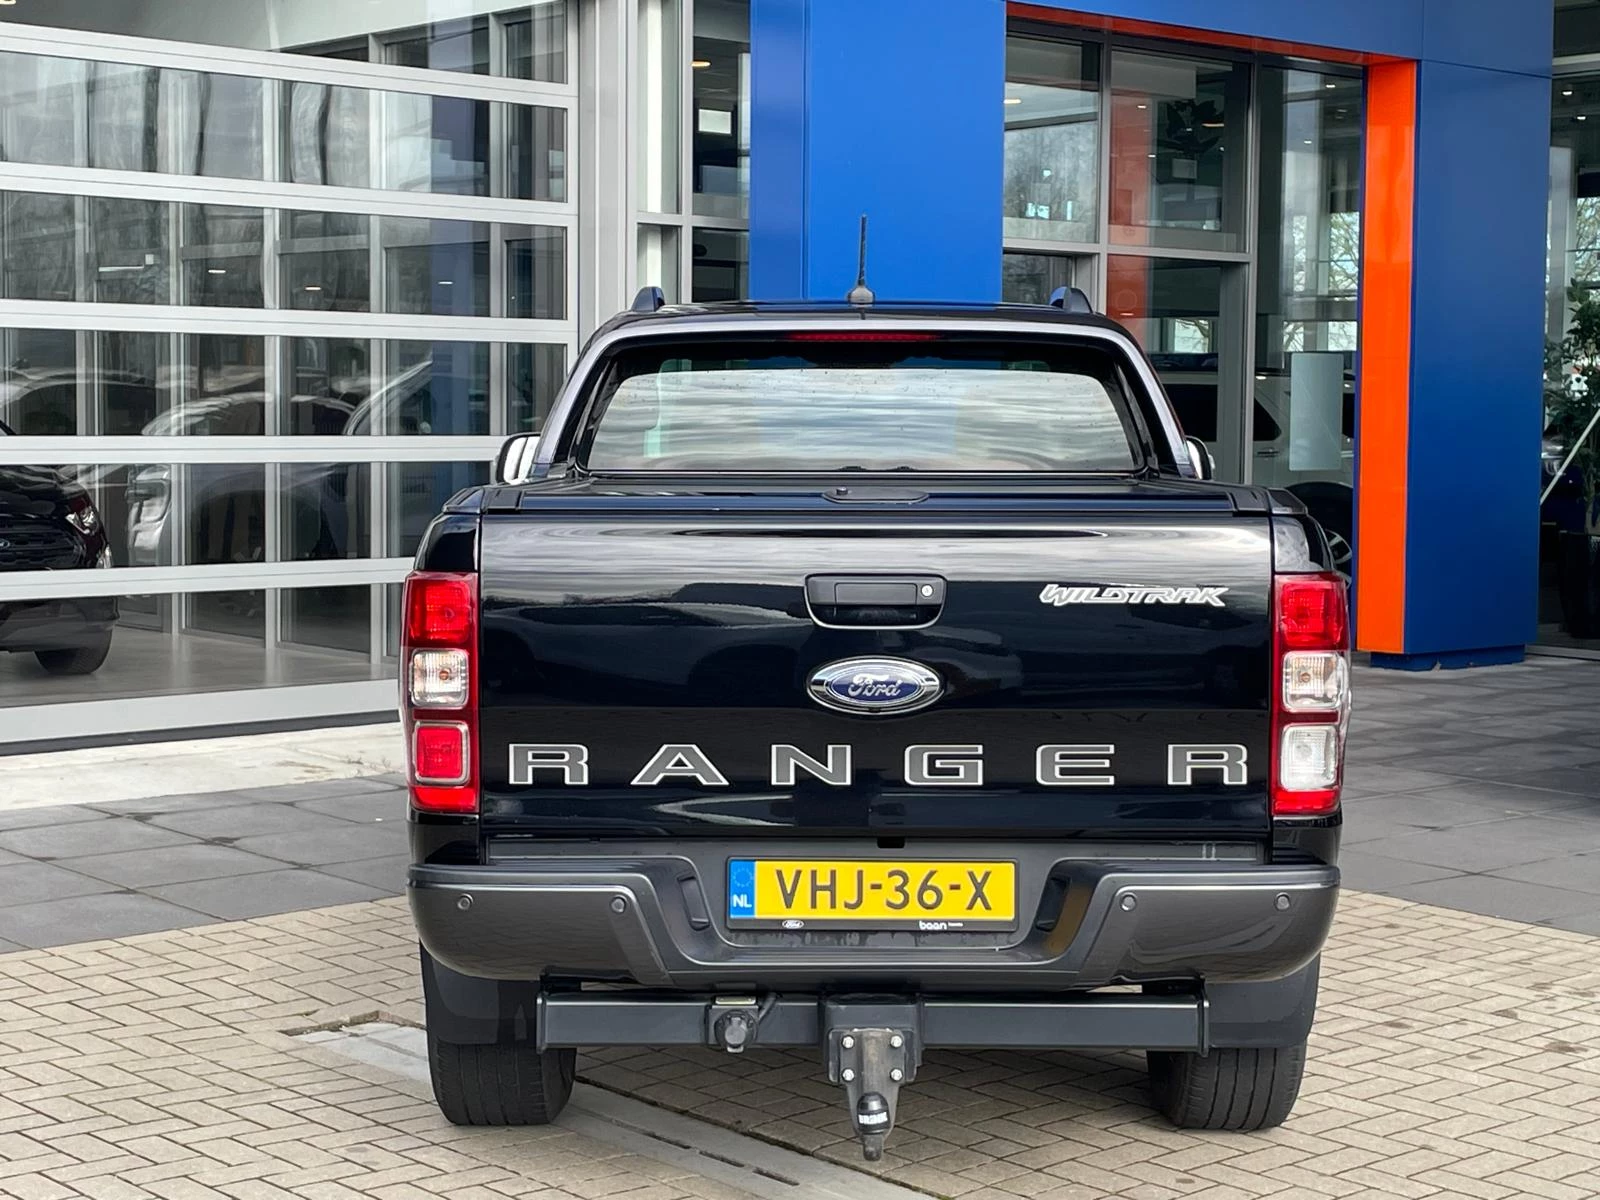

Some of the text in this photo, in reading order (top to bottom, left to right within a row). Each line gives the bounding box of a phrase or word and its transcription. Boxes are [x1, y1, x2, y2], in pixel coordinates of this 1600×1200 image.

[1039, 584, 1229, 607] WILDTRAK
[848, 673, 903, 697] Ford
[509, 743, 1247, 785] RANGER
[732, 894, 752, 908] NL
[776, 869, 992, 911] VHJ-36-X
